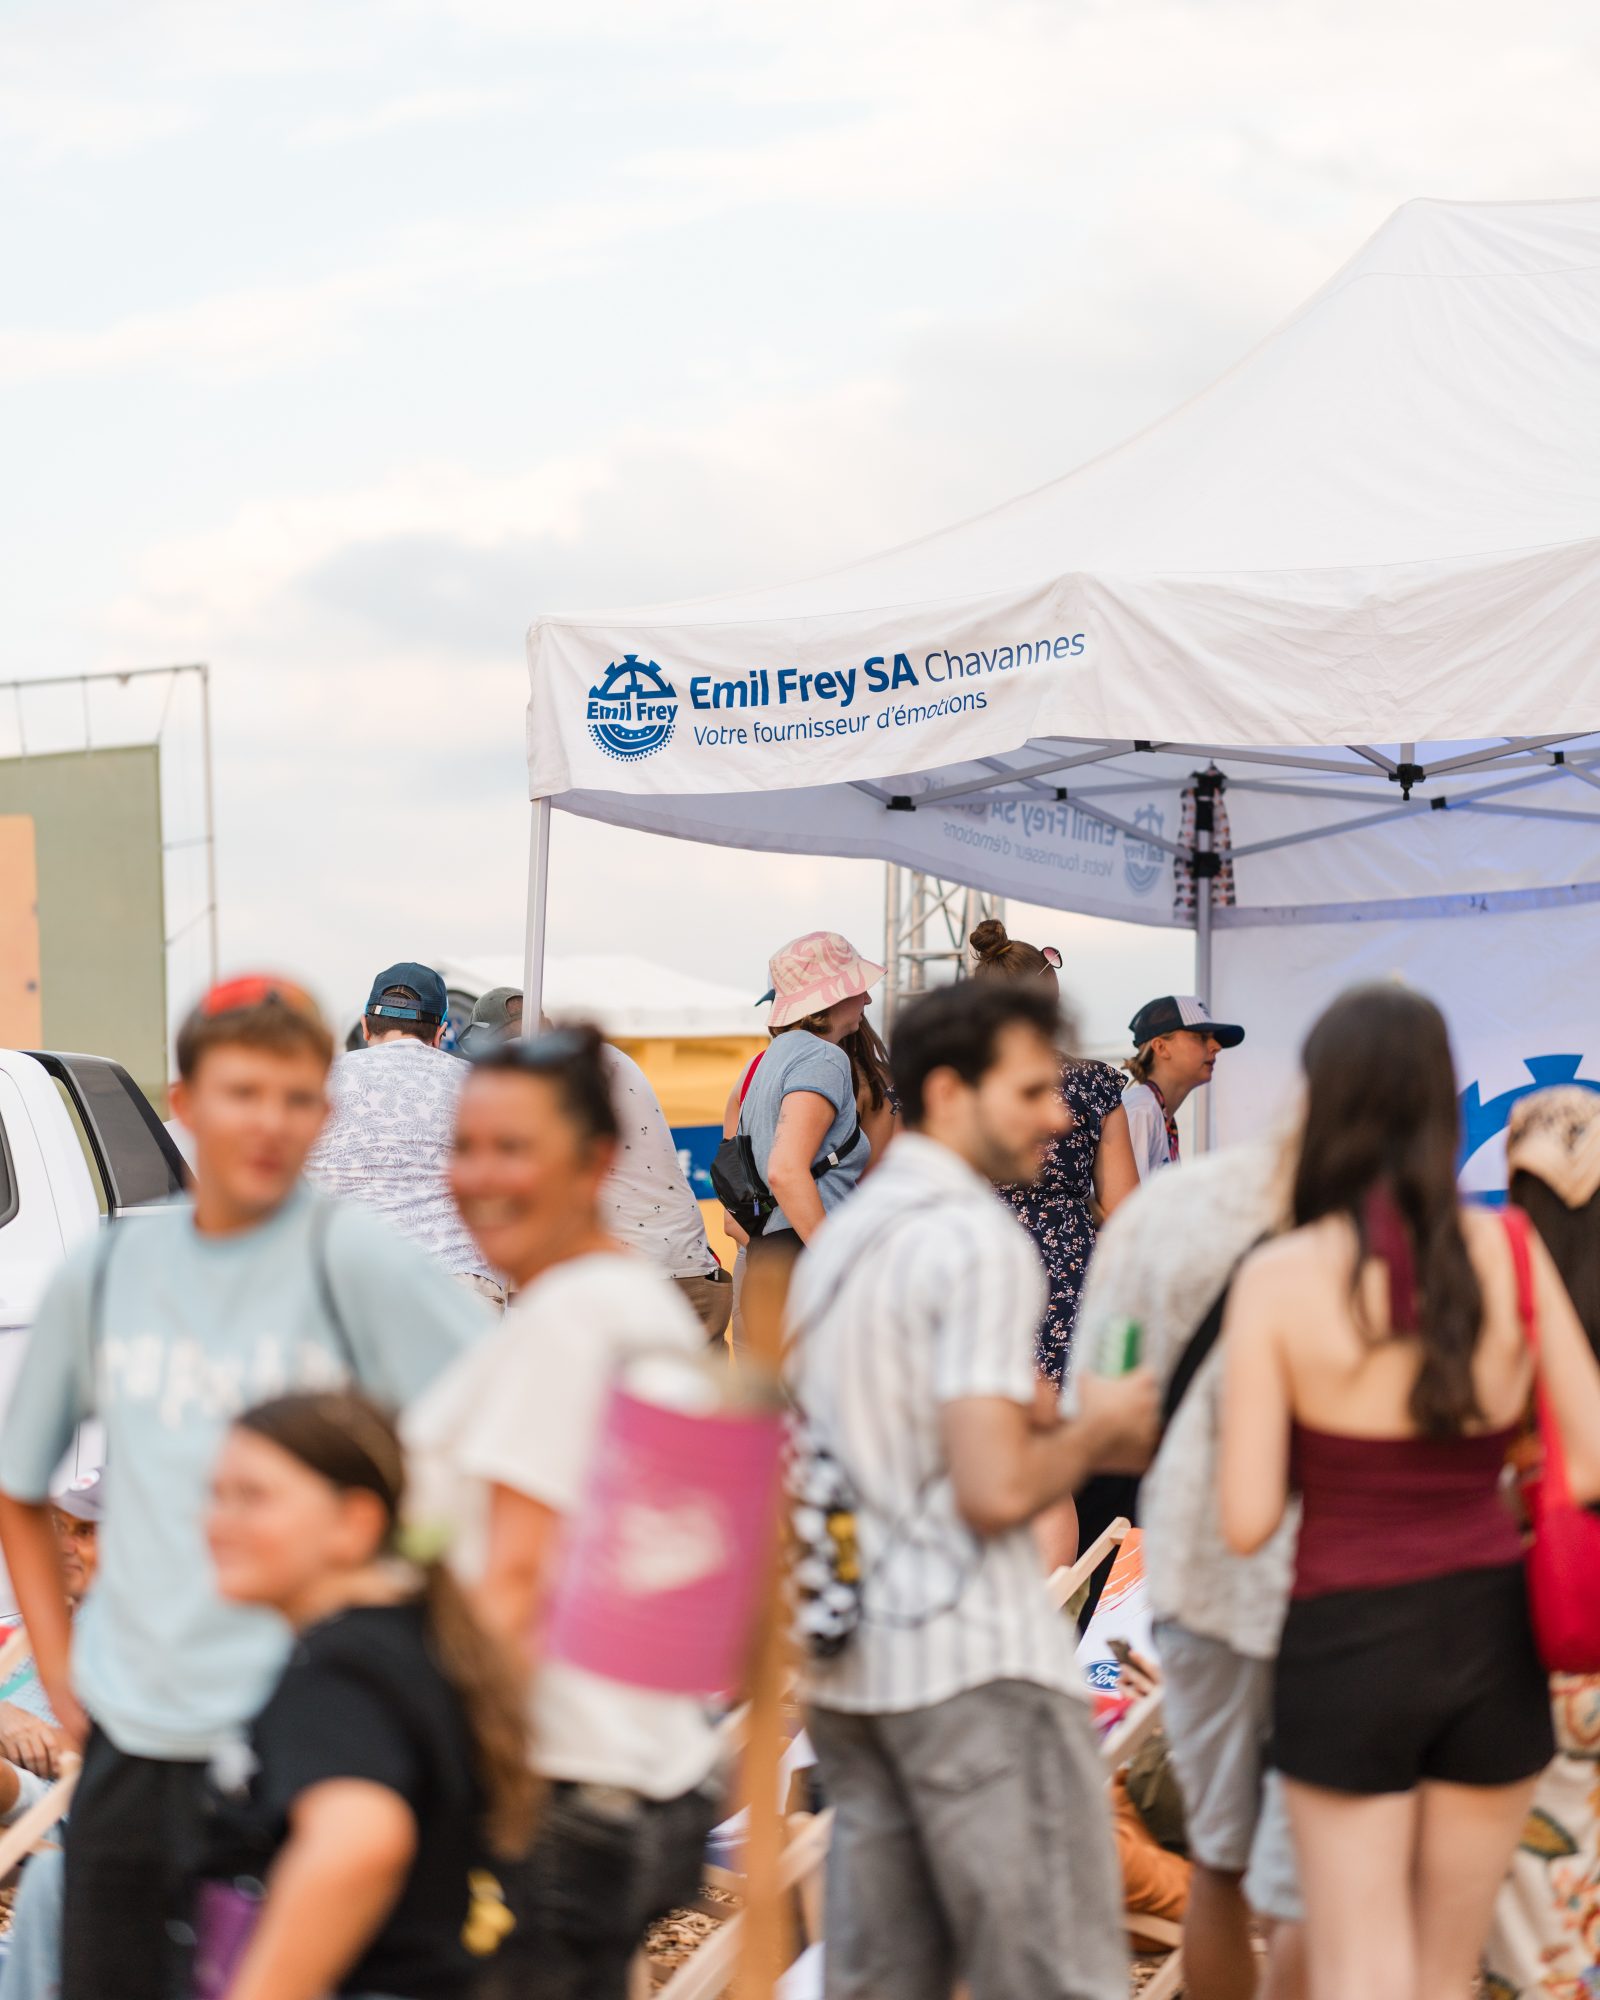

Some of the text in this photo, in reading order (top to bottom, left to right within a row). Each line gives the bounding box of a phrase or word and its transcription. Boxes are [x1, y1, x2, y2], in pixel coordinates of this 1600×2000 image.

[690, 633, 1085, 709] Emil Frey SA Chavannes
[586, 701, 678, 723] Emil Frey
[694, 725, 747, 745] Votre
[753, 713, 870, 743] fournisseur
[1087, 1664, 1122, 1687] For
